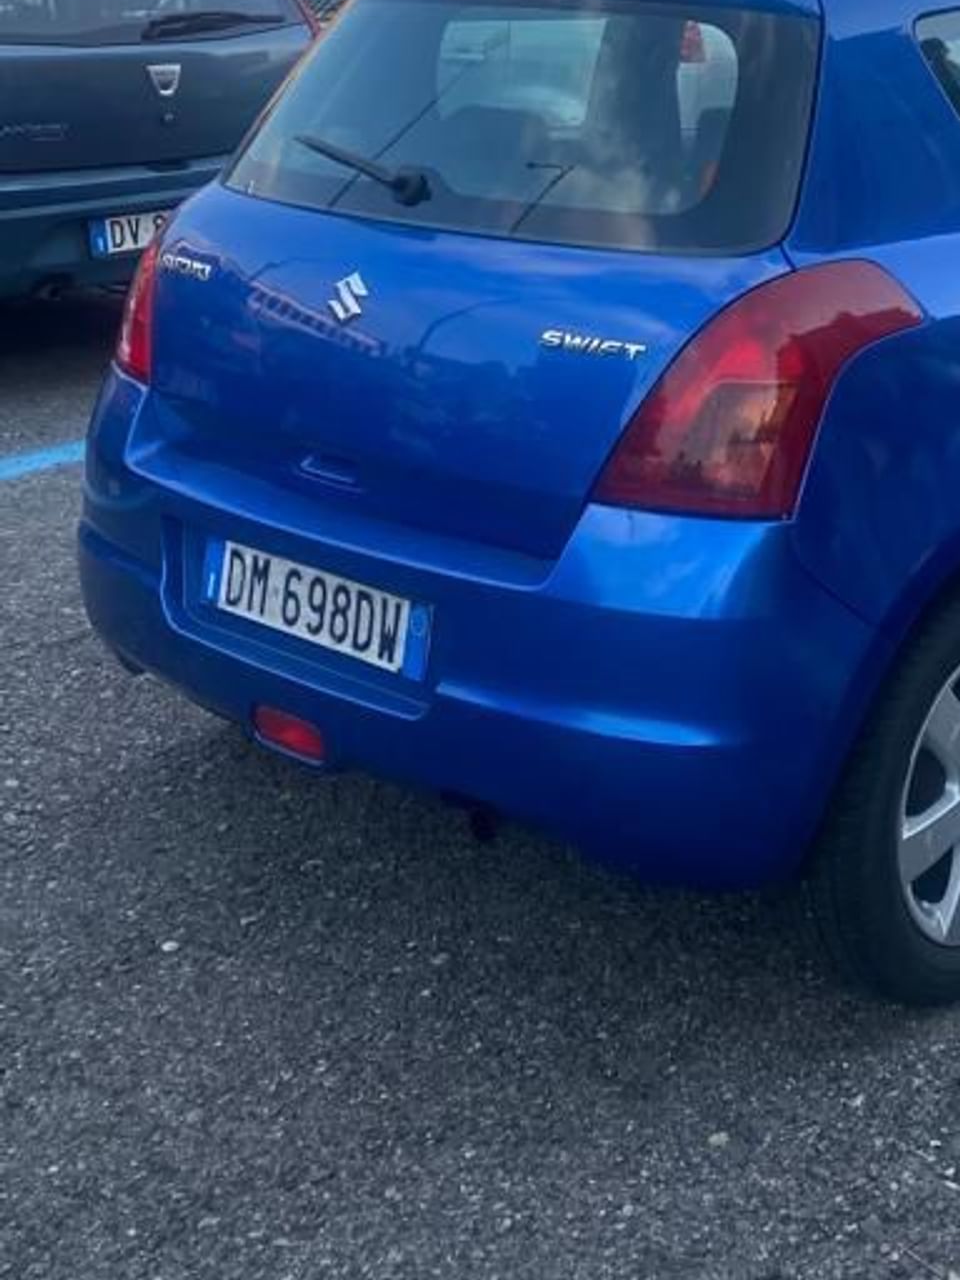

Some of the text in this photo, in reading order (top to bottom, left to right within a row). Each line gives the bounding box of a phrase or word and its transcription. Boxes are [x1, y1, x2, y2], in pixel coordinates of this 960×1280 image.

[109, 217, 140, 250] DV
[541, 329, 647, 361] SWIFT
[225, 549, 403, 664] DM 698DW
